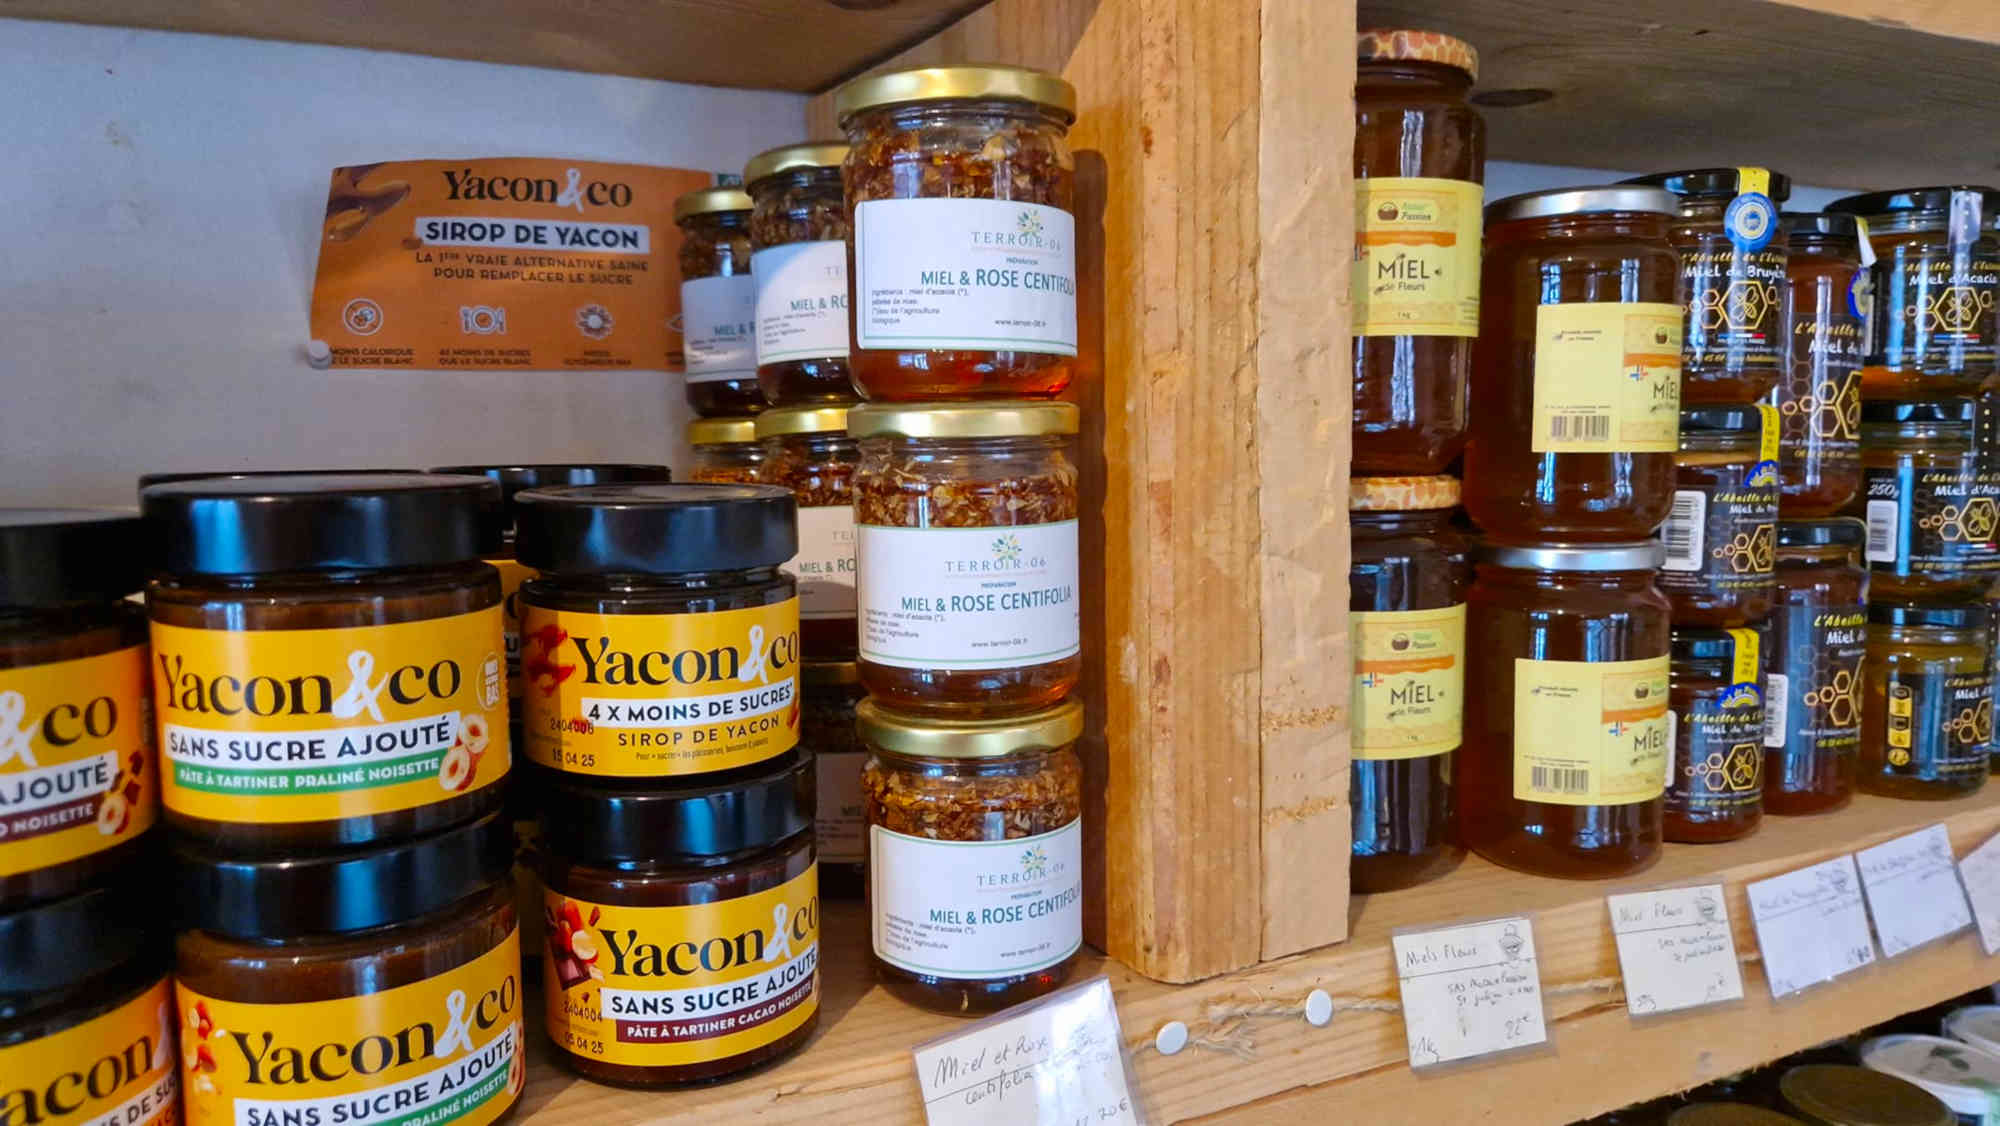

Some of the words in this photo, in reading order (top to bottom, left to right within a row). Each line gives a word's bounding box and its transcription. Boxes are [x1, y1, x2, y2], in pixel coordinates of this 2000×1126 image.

[443, 168, 633, 213] Yacon&co
[425, 222, 506, 242] SIROP
[514, 225, 547, 244] DE
[555, 227, 639, 248] YACON
[416, 252, 433, 263] LA
[466, 255, 508, 266] VRAIE
[514, 256, 602, 270] ALTERNATIVE
[609, 260, 649, 272] SAINE
[434, 267, 474, 279] POUR
[480, 268, 564, 283] REMPLACER
[569, 273, 586, 284] LE
[1378, 259, 1431, 280] MIEL
[921, 271, 954, 286] MIEL
[960, 271, 970, 286] &
[976, 268, 1019, 288] ROSE
[790, 298, 815, 311] MIEL
[944, 557, 1048, 573] TERROIR-06
[902, 597, 931, 612] MIEL
[936, 597, 946, 612] &
[952, 594, 995, 613] ROSE
[1001, 584, 1073, 610] CENTIFOLIA
[1826, 631, 1854, 645] Miel
[570, 624, 799, 685] Yacon&co
[159, 650, 462, 722] Yacon&co
[1390, 684, 1435, 705] MIEL
[588, 704, 600, 720] 4
[628, 703, 700, 722] MOINS
[708, 697, 734, 717] DE
[170, 732, 220, 759] SANS
[229, 739, 326, 761] SUCRE
[337, 715, 450, 758] AJOUTÉ
[618, 731, 683, 747] SIROP
[693, 727, 718, 744] DE
[727, 714, 779, 741] YACON
[180, 767, 203, 785] PÂTE
[206, 766, 215, 785] À
[217, 774, 289, 789] TARTINER
[295, 767, 365, 789] PRALINÉ
[368, 757, 440, 780] NOISETTE
[581, 754, 595, 768] 25
[14, 802, 95, 834] NOISETTE
[930, 908, 961, 924] MIEL
[966, 911, 977, 924] &
[982, 904, 1023, 924] ROSE
[599, 896, 818, 977] Yacon&co
[612, 995, 674, 1016] SANS
[683, 981, 759, 1012] SUCRE
[230, 974, 516, 1086] Yacon&co
[627, 1022, 658, 1039] PÂTE
[660, 1020, 671, 1038] À
[673, 1017, 736, 1037] TARTINER
[738, 1003, 777, 1026] CACAO
[591, 1041, 605, 1054] 25
[247, 1107, 322, 1126] SANS
[339, 1081, 430, 1126] SUCRE
[439, 1028, 513, 1095] AJOUTÉ
[933, 1047, 986, 1089] Miel
[463, 1069, 508, 1111] NOISETTE
